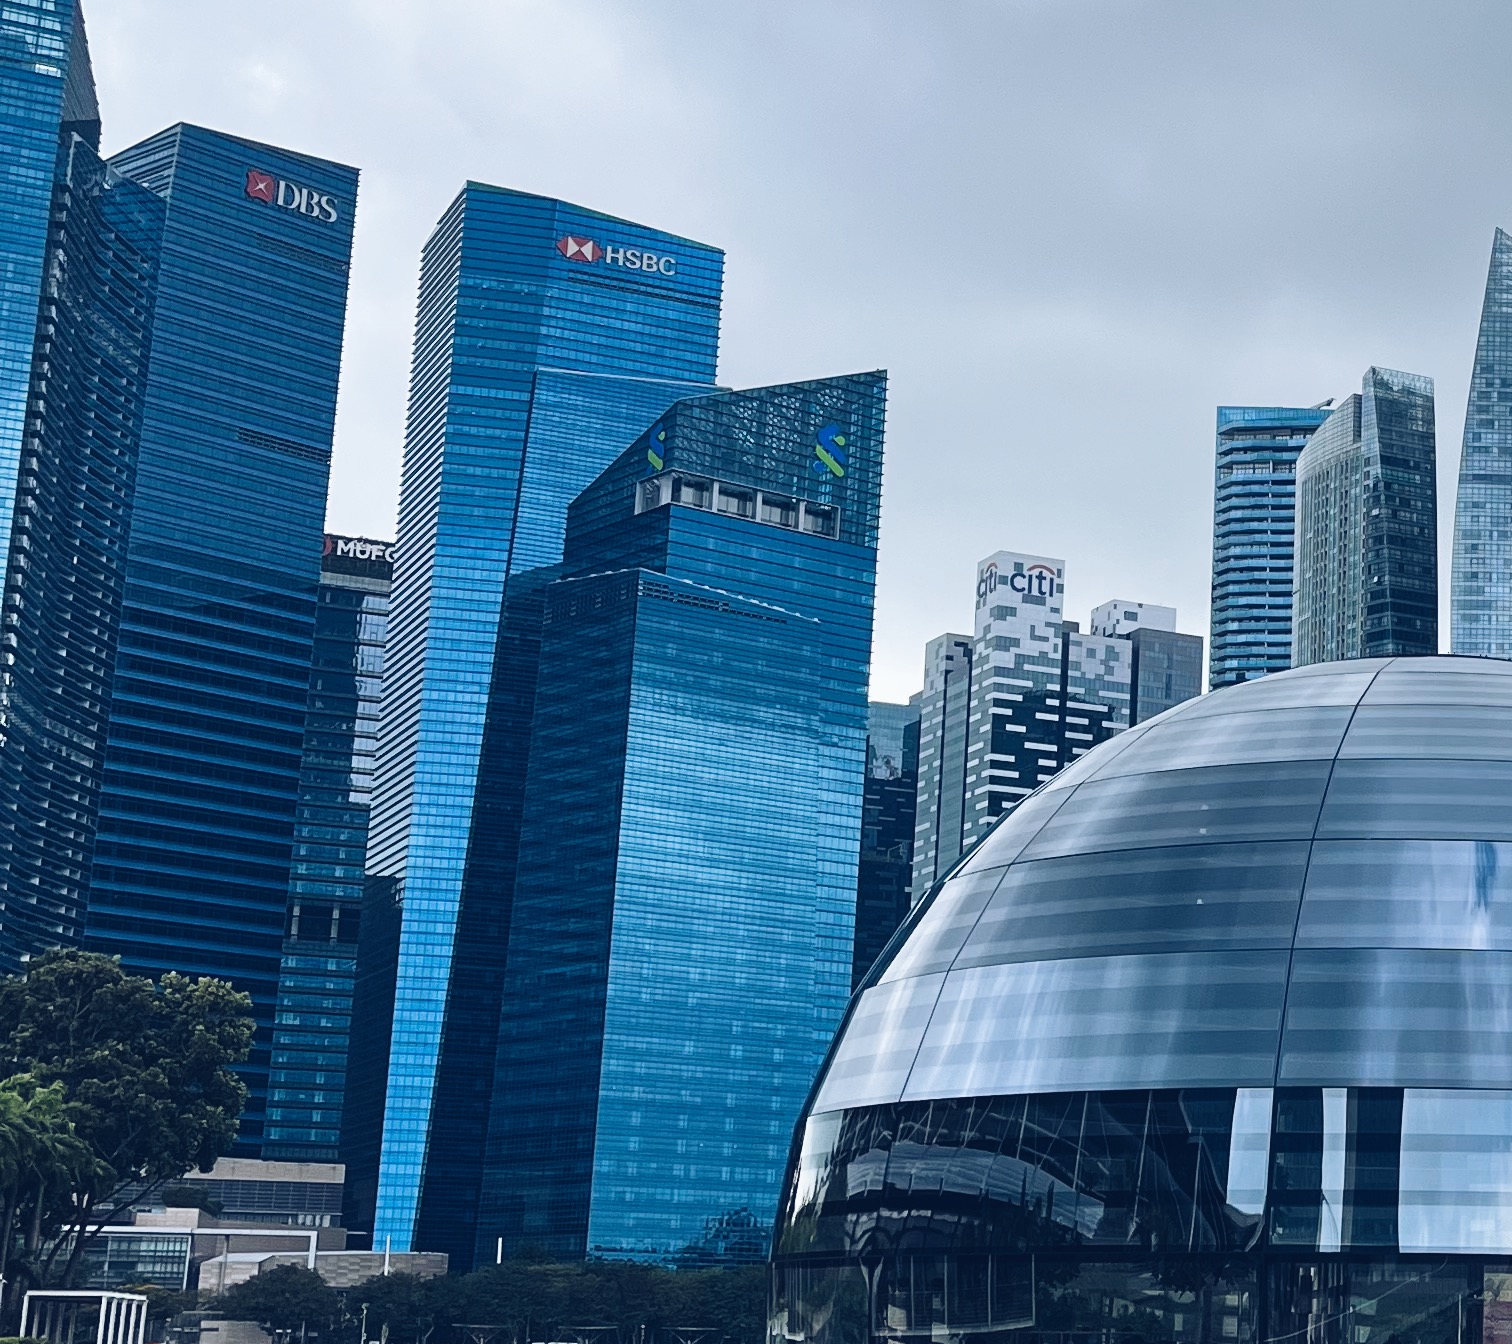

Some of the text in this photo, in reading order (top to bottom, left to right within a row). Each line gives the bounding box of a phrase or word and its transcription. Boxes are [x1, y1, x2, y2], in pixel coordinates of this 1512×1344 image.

[277, 180, 337, 223] DBS
[605, 245, 676, 275] HSBC
[1010, 570, 1055, 598] citi
